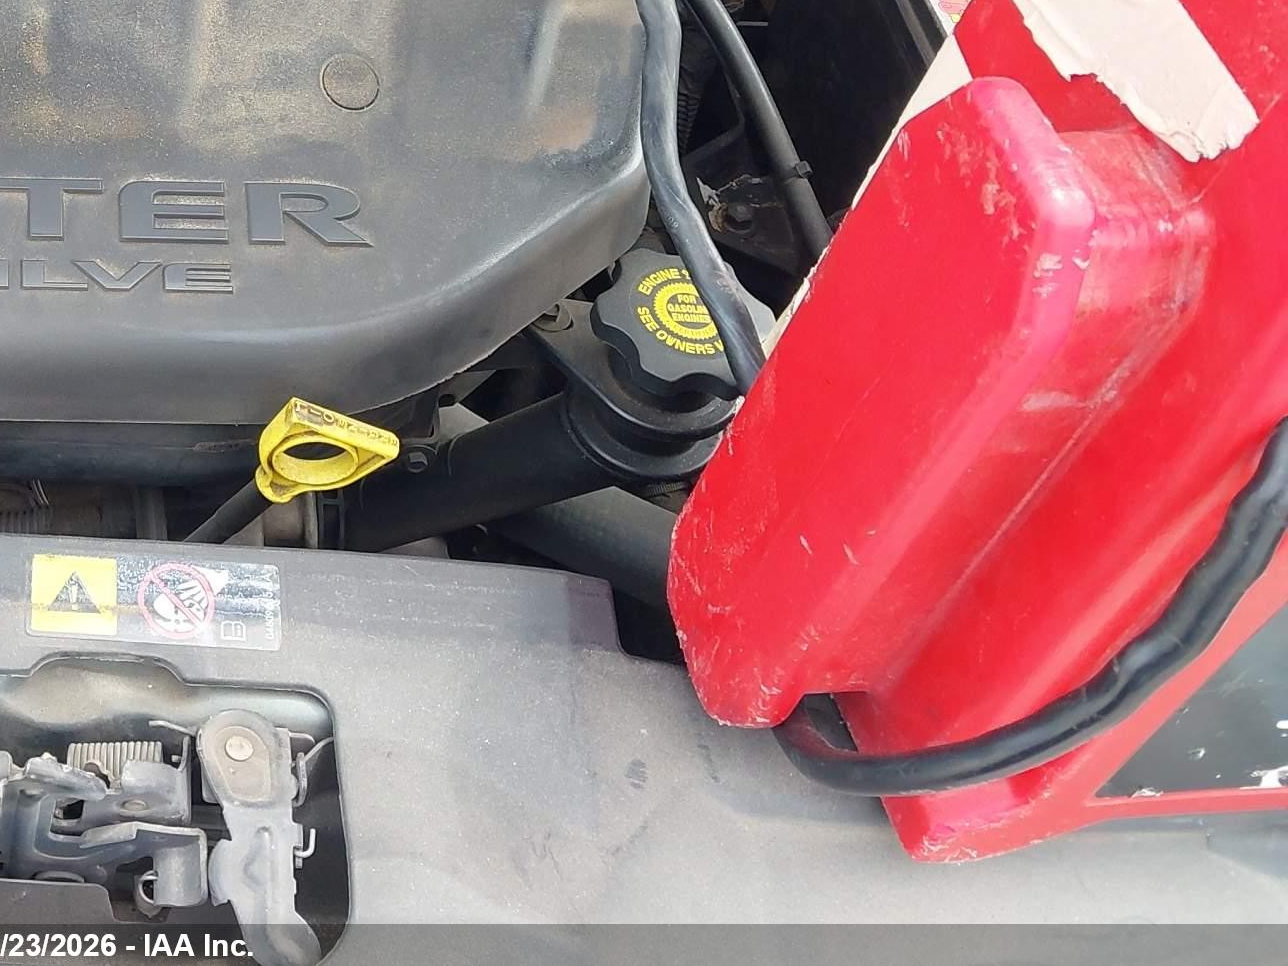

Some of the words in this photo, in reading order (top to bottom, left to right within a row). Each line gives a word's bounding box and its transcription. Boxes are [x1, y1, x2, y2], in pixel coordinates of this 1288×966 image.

[637, 267, 680, 296] ENGINE
[667, 303, 709, 314] GASOLIN
[677, 295, 697, 304] FOR
[637, 307, 658, 332] SEE
[656, 330, 715, 355] OWNERS
